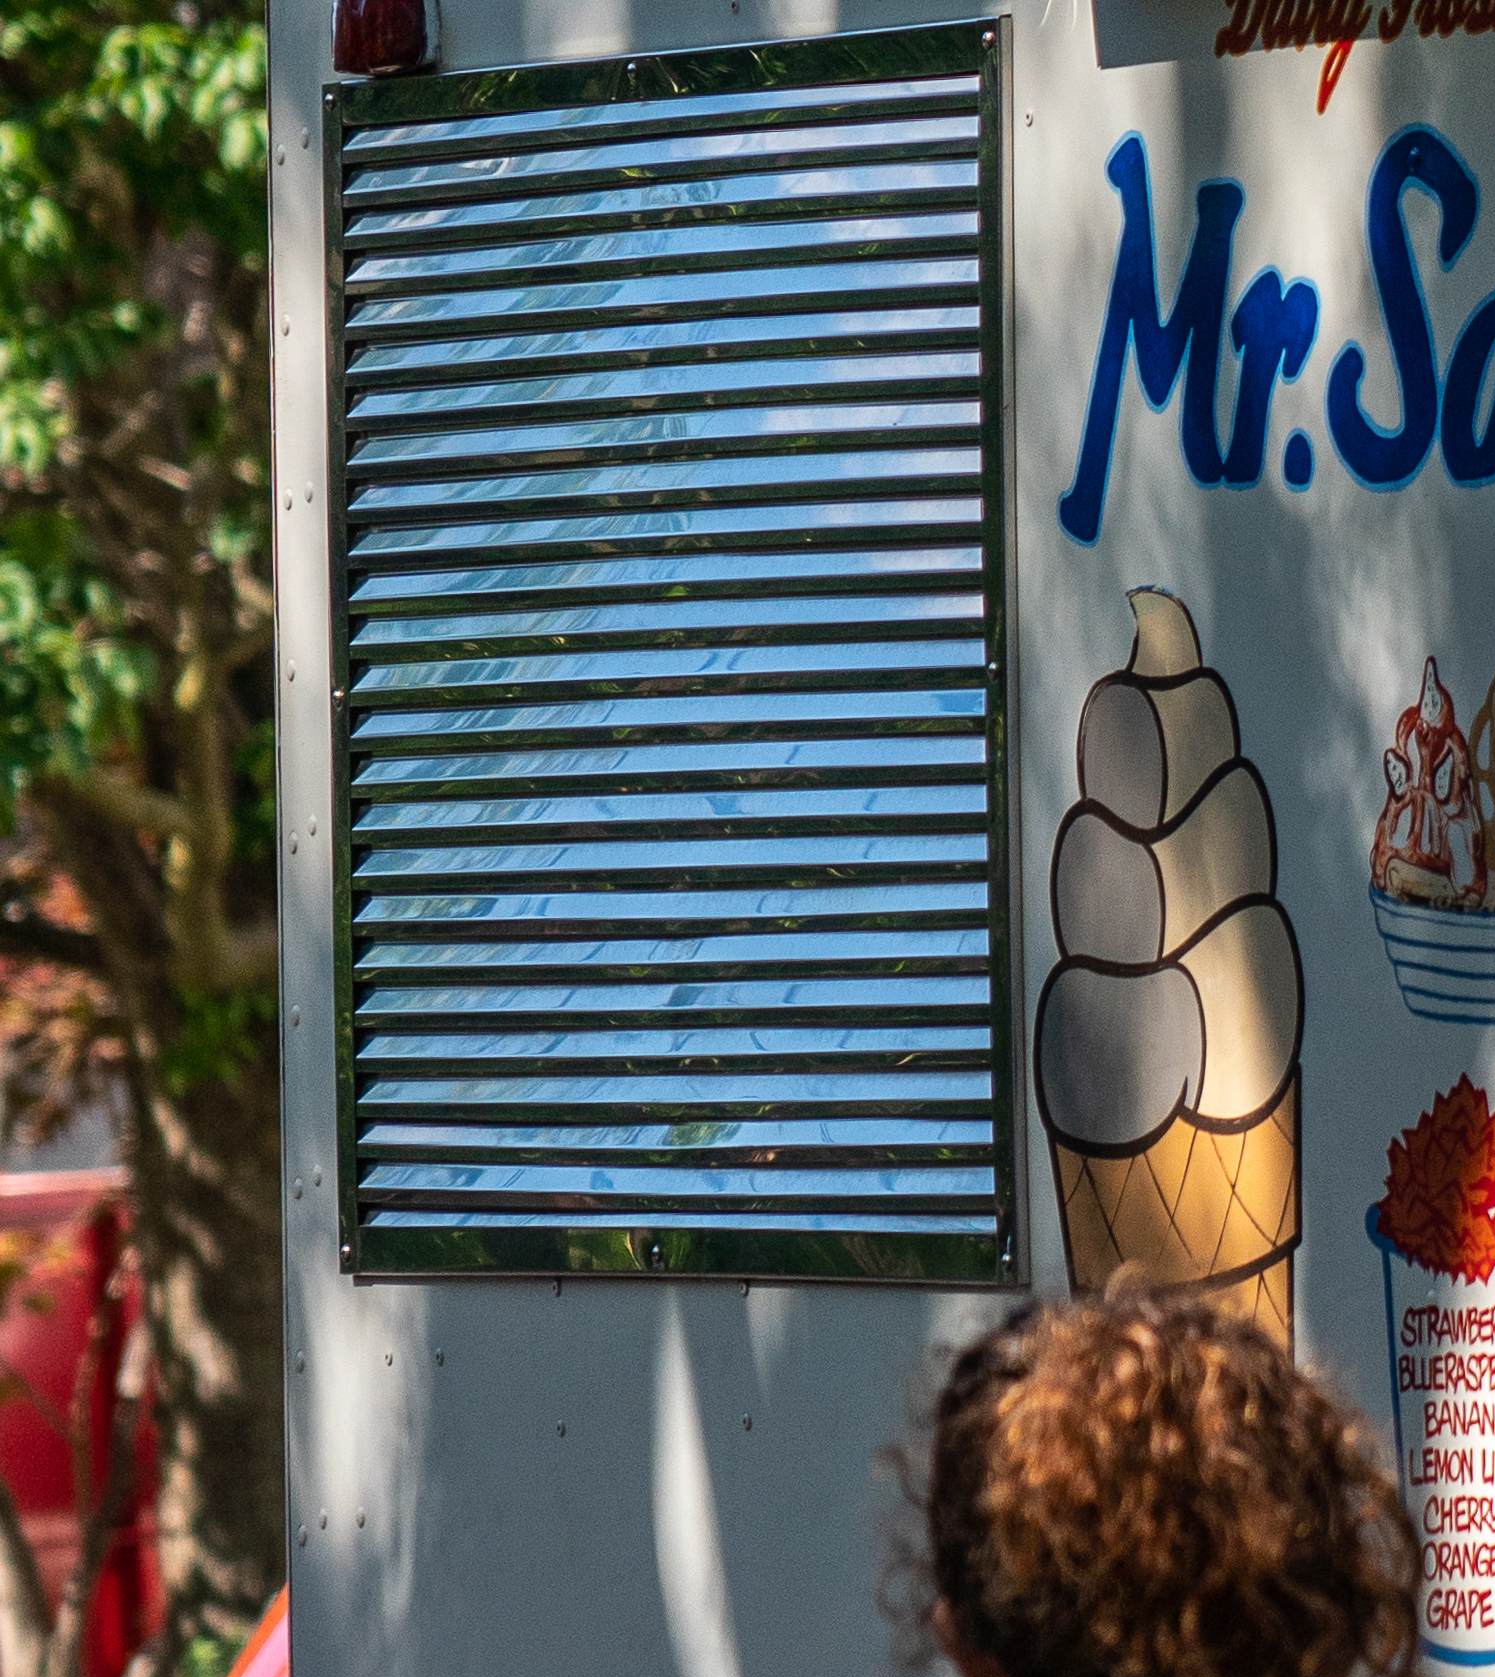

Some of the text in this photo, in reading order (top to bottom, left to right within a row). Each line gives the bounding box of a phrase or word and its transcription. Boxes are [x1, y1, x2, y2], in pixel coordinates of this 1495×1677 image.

[1058, 130, 1316, 546] Mr.
[1409, 1448, 1475, 1485] LEMON
[1425, 1588, 1495, 1629] GRAPE
